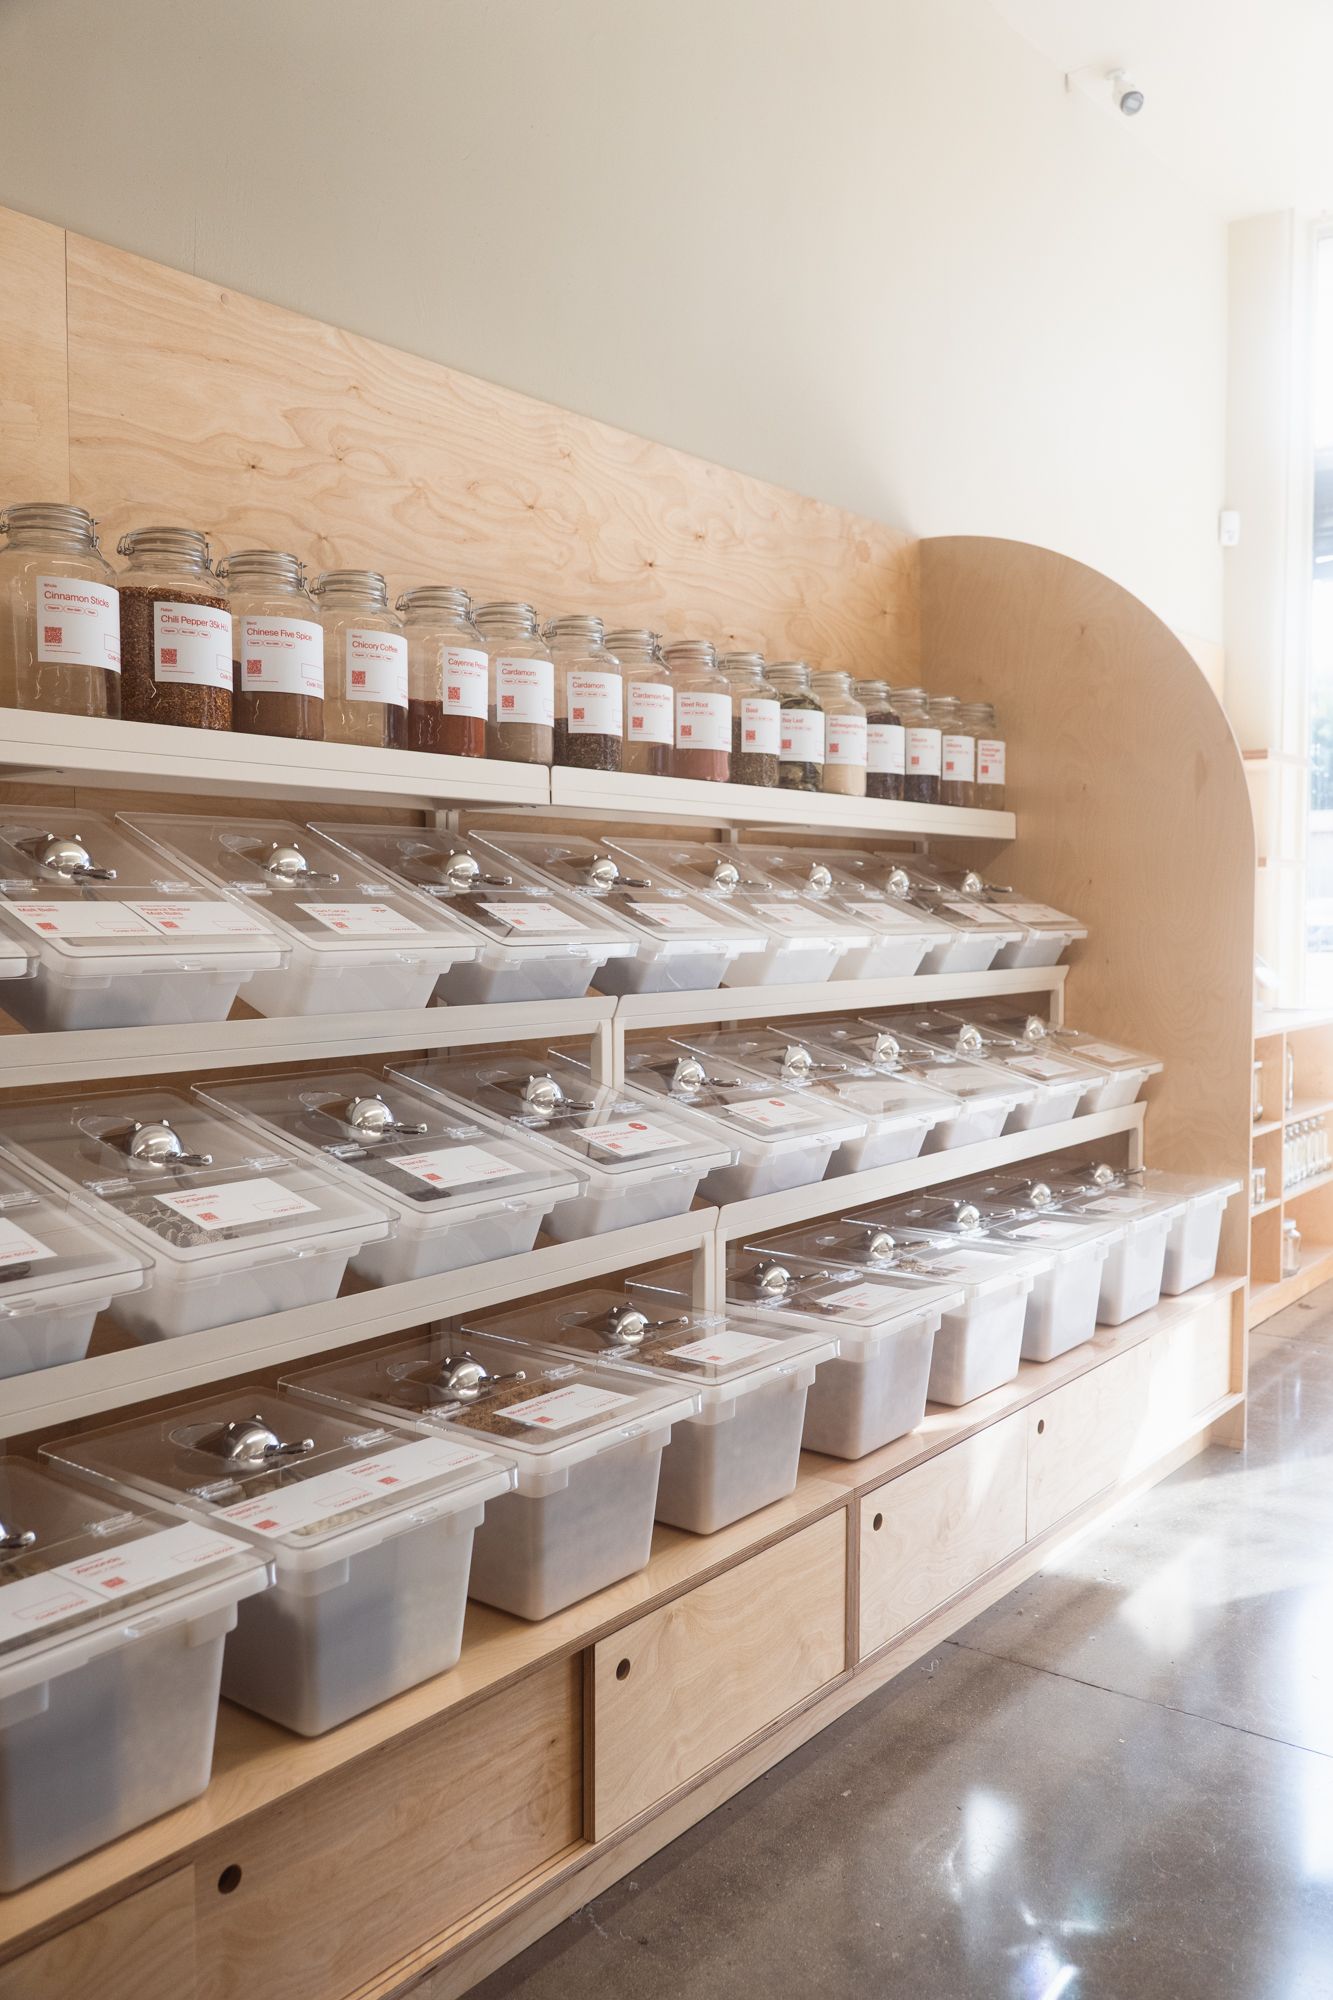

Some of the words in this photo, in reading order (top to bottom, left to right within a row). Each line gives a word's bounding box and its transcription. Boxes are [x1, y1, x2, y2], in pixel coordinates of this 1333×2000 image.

[44, 590, 89, 603] Cinnamon
[91, 596, 110, 608] Sticks
[161, 614, 180, 624] Chili
[181, 615, 208, 627] Pepper
[247, 627, 279, 637] Chinese
[280, 629, 295, 639] Five
[352, 640, 379, 651] Chicory
[448, 658, 474, 668] Cayenne
[502, 668, 537, 677] Cardamom
[572, 681, 606, 689] Cardamom
